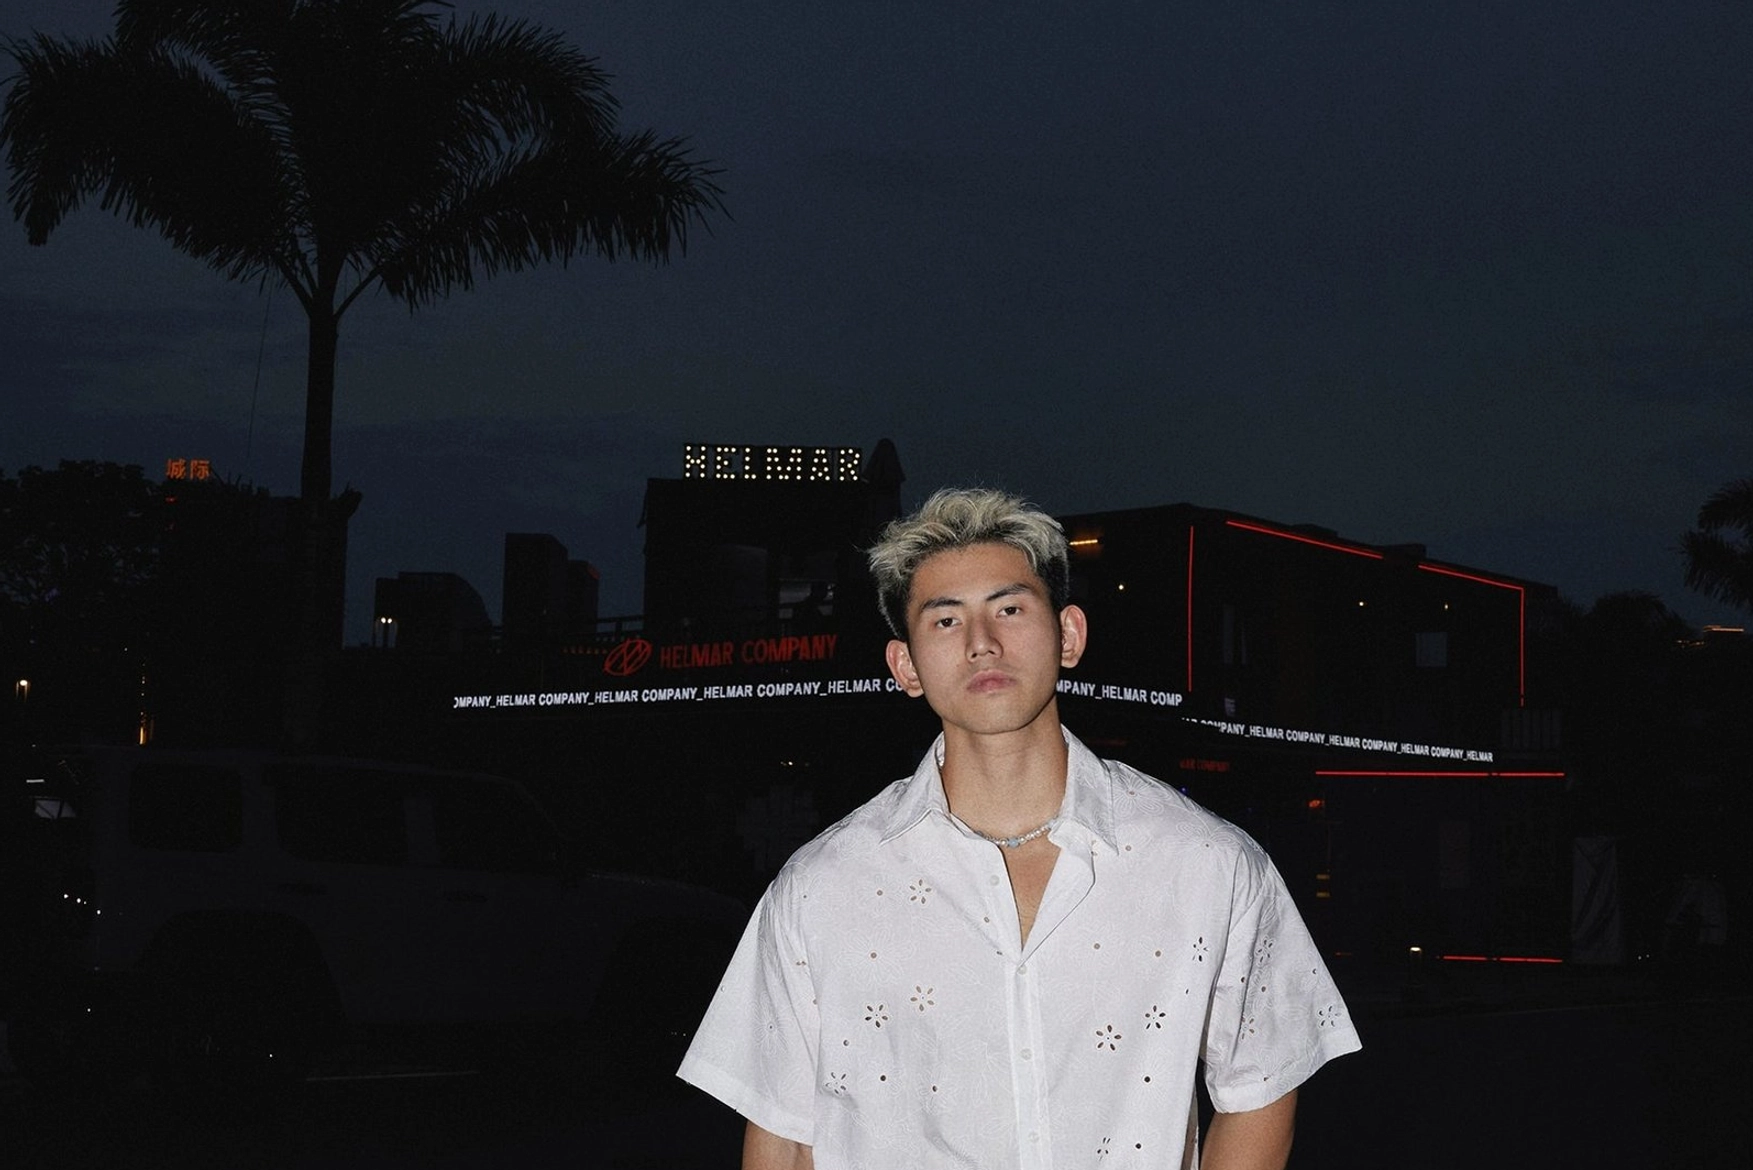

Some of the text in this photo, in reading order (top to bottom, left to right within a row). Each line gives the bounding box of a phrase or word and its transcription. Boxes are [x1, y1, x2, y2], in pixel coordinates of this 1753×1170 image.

[166, 458, 209, 479] 城际
[685, 445, 861, 481] HELMAR
[660, 635, 837, 668] HELMAR COMPANY
[1149, 691, 1183, 707] COMP
